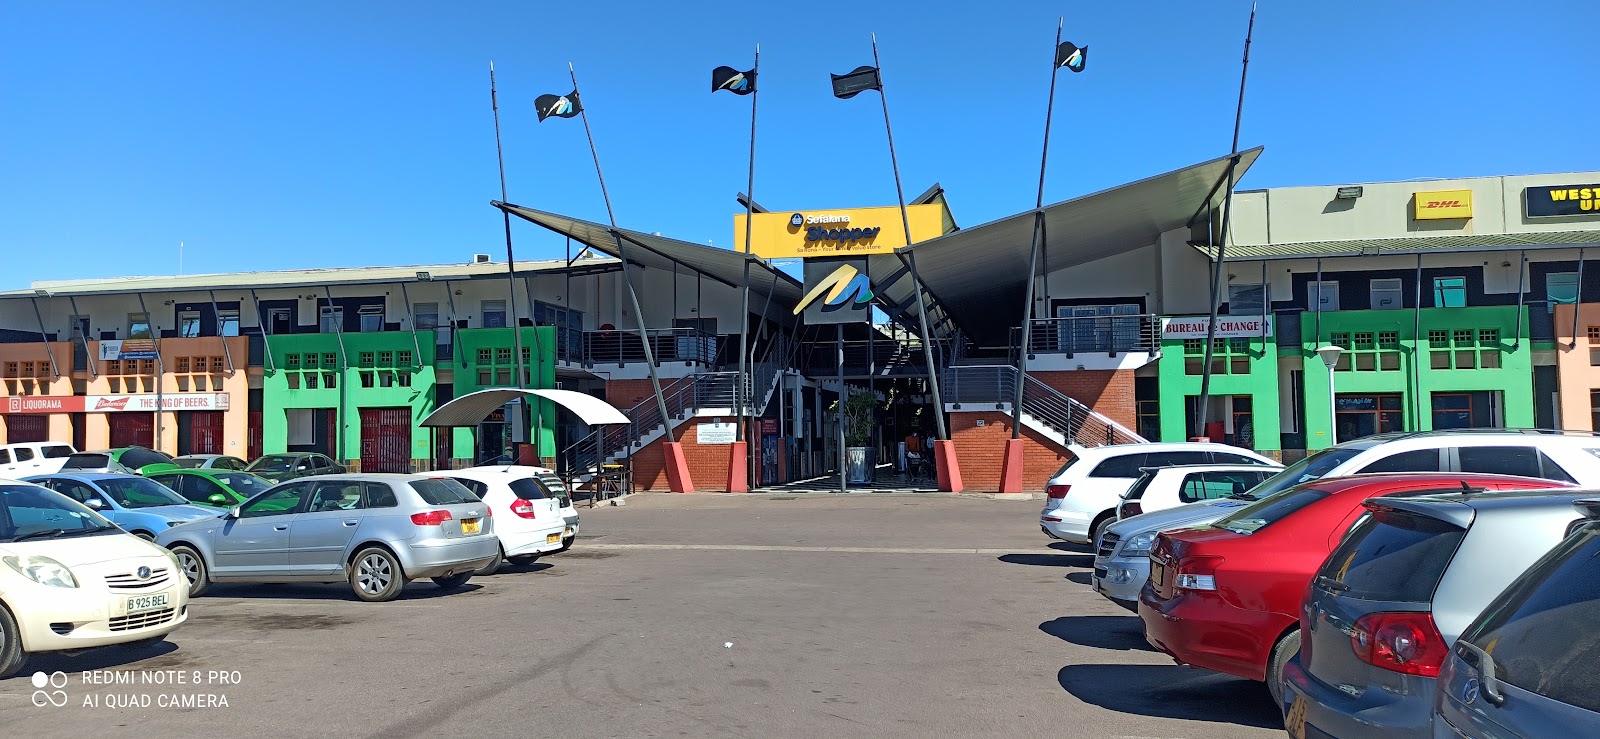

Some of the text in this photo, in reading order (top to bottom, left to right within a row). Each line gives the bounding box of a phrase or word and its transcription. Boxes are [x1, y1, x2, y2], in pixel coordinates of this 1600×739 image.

[1426, 200, 1461, 209] DHL
[806, 215, 850, 224] Sefalana
[807, 226, 881, 243] Shopper
[1166, 324, 1204, 333] BUREAU
[1220, 321, 1259, 331] CHANGE
[22, 400, 62, 410] LIQUORAMA
[140, 399, 153, 408] THE
[155, 398, 172, 408] KNG
[174, 398, 183, 407] OF
[185, 397, 210, 407] BEERS.
[128, 594, 168, 610] B 925 BEL
